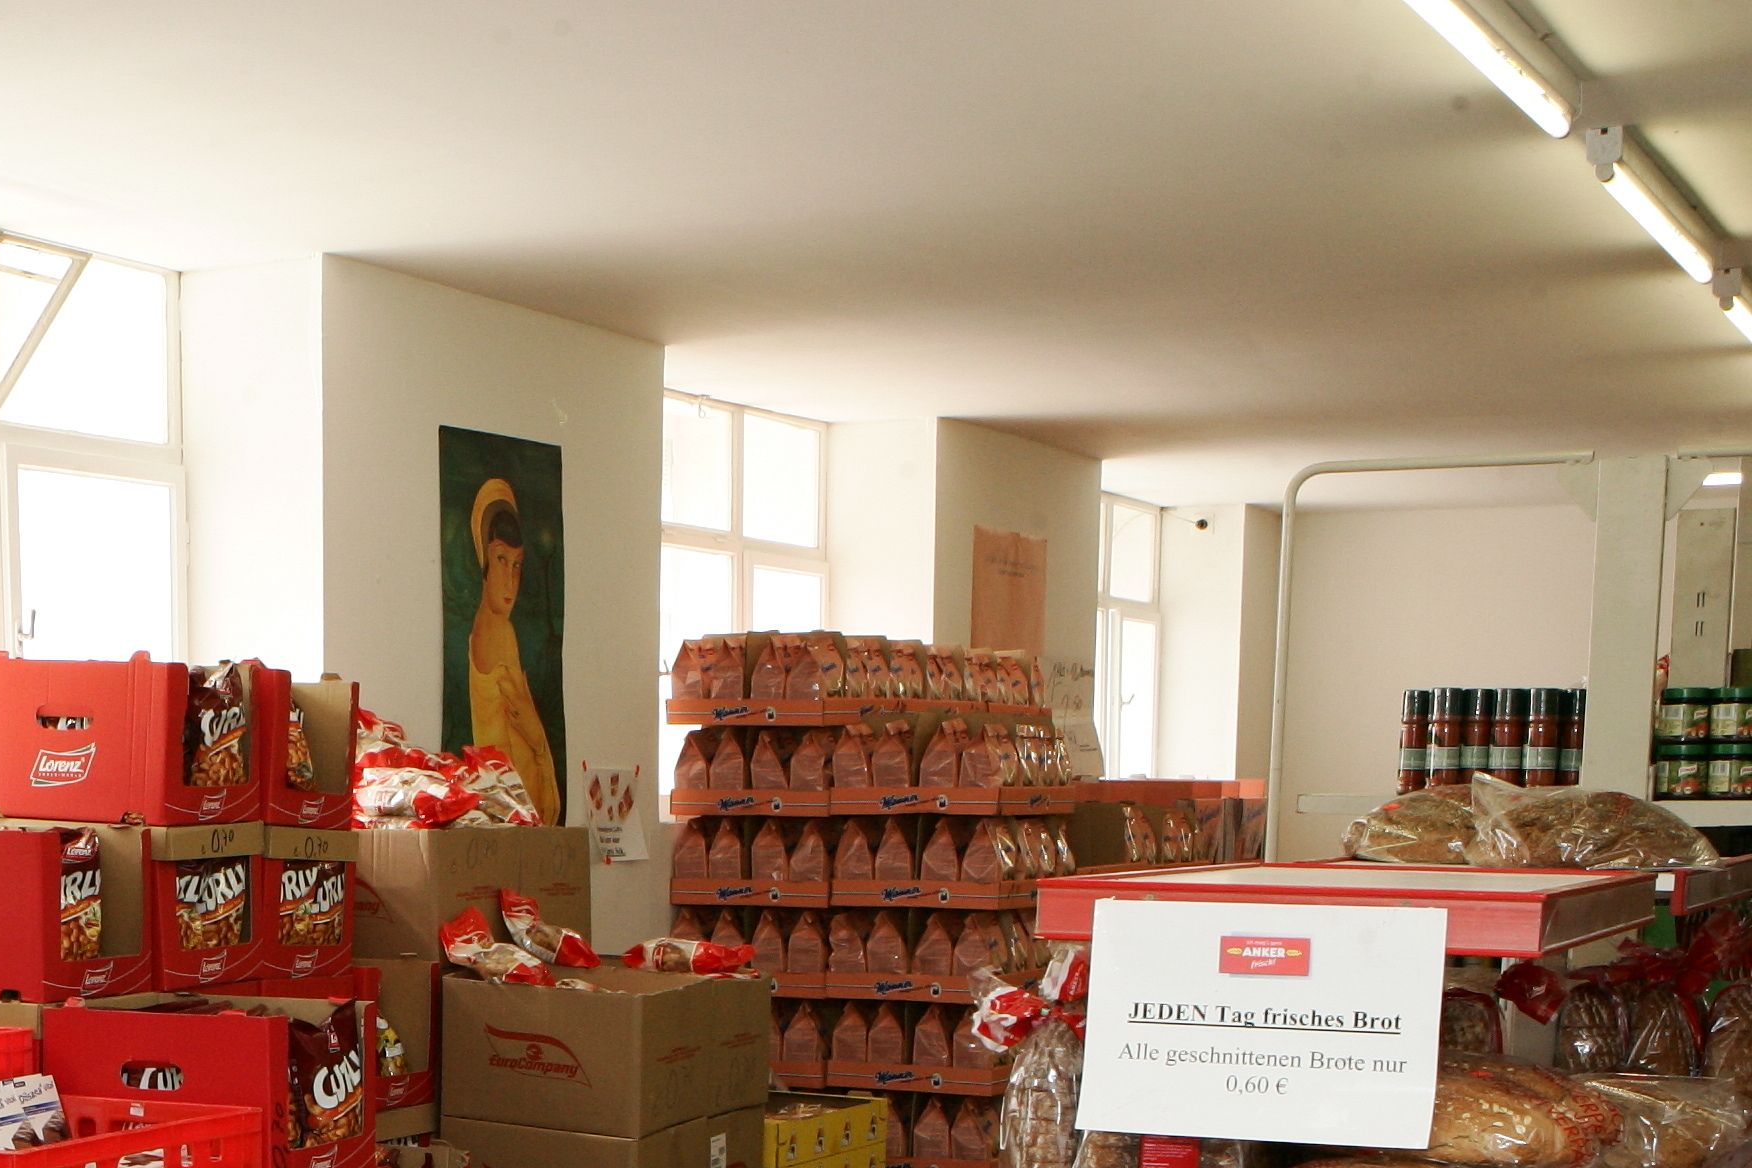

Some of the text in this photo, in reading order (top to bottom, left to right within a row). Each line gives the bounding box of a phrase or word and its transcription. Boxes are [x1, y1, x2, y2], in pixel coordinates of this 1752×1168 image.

[38, 756, 85, 773] Lorenz
[211, 829, 235, 853] 0,70
[1242, 947, 1286, 958] ANKER
[1128, 1002, 1402, 1031] JEDEN Tag frisches Brot
[488, 1055, 579, 1078] EuroCompany
[1118, 1042, 1408, 1074] Alle geschnittenen Brote nur
[1225, 1074, 1289, 1095] 0,60 €
